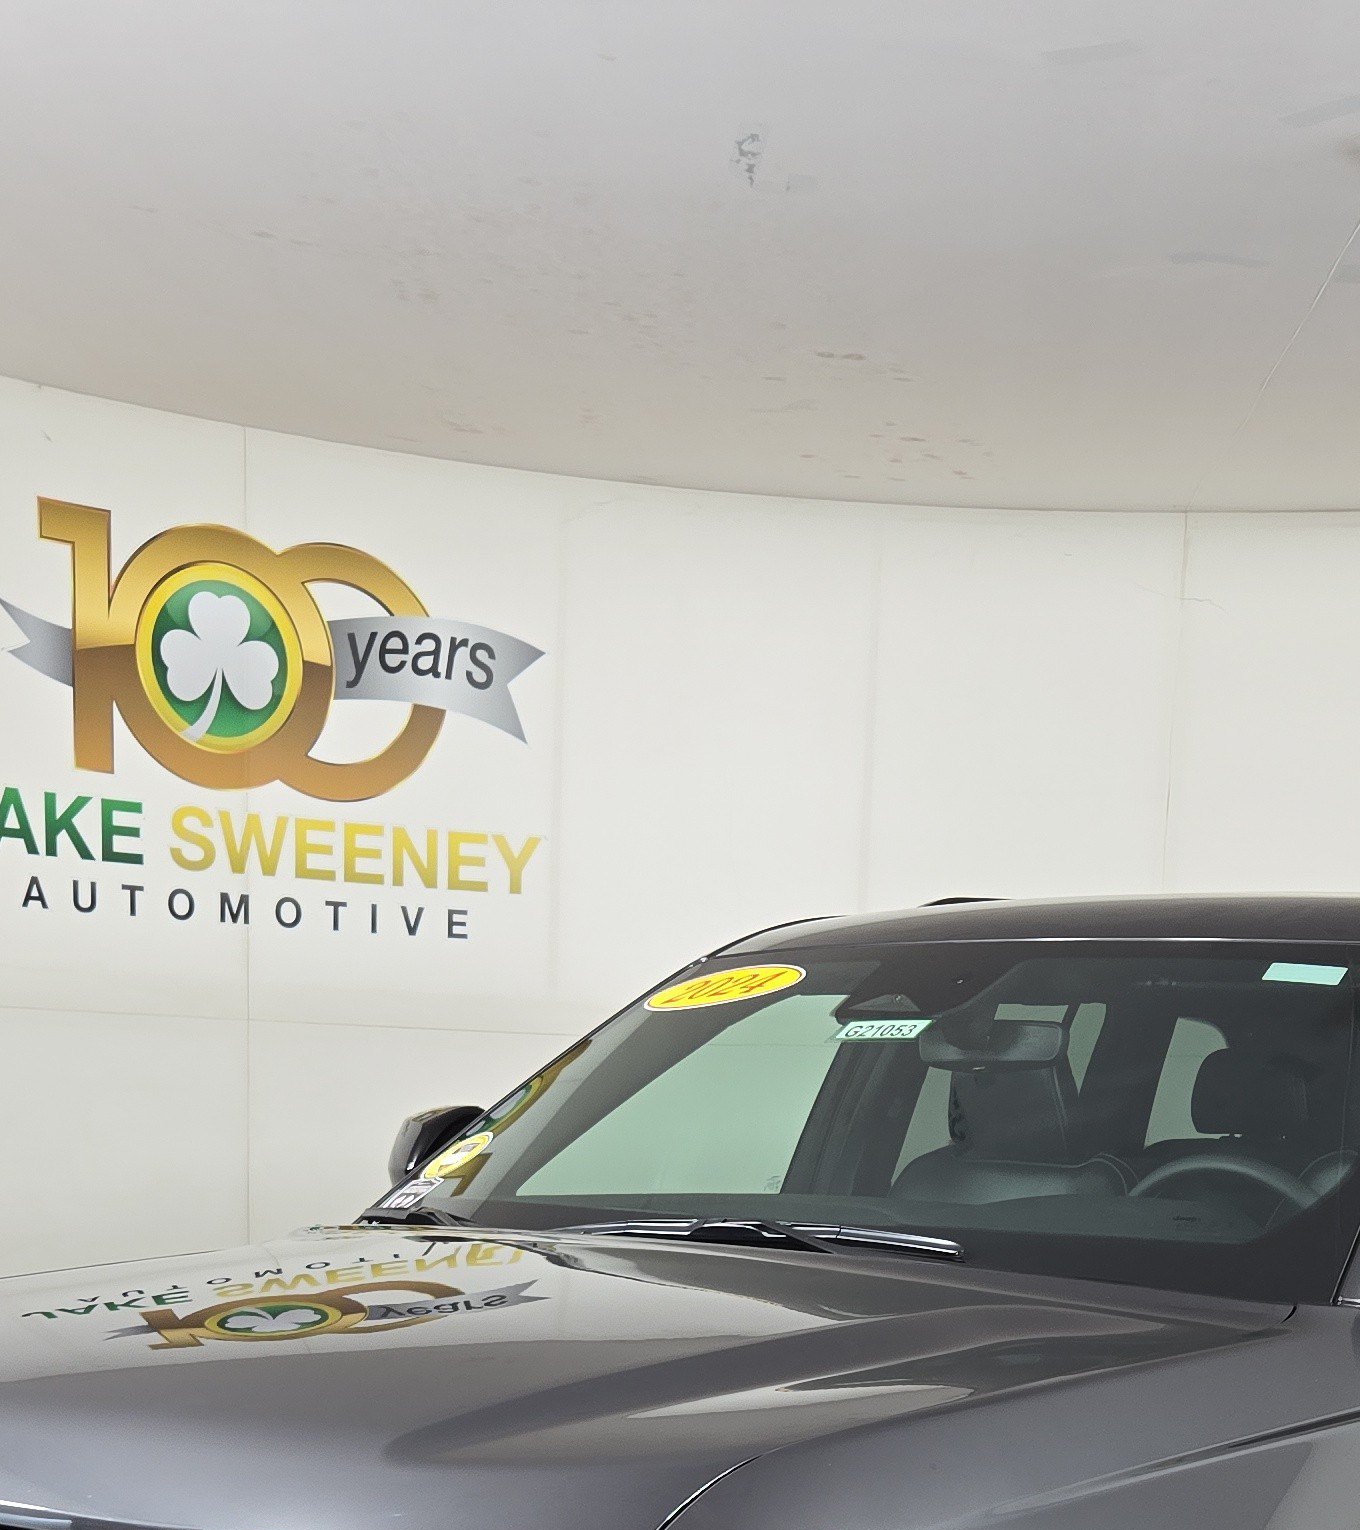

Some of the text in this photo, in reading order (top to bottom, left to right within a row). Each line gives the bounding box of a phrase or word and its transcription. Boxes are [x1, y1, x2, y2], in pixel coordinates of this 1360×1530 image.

[345, 630, 497, 690] years
[169, 804, 542, 894] SWEENEY
[22, 875, 469, 939] AUTOMOTIVE
[660, 970, 789, 1004] 2024
[844, 1024, 918, 1038] G21053
